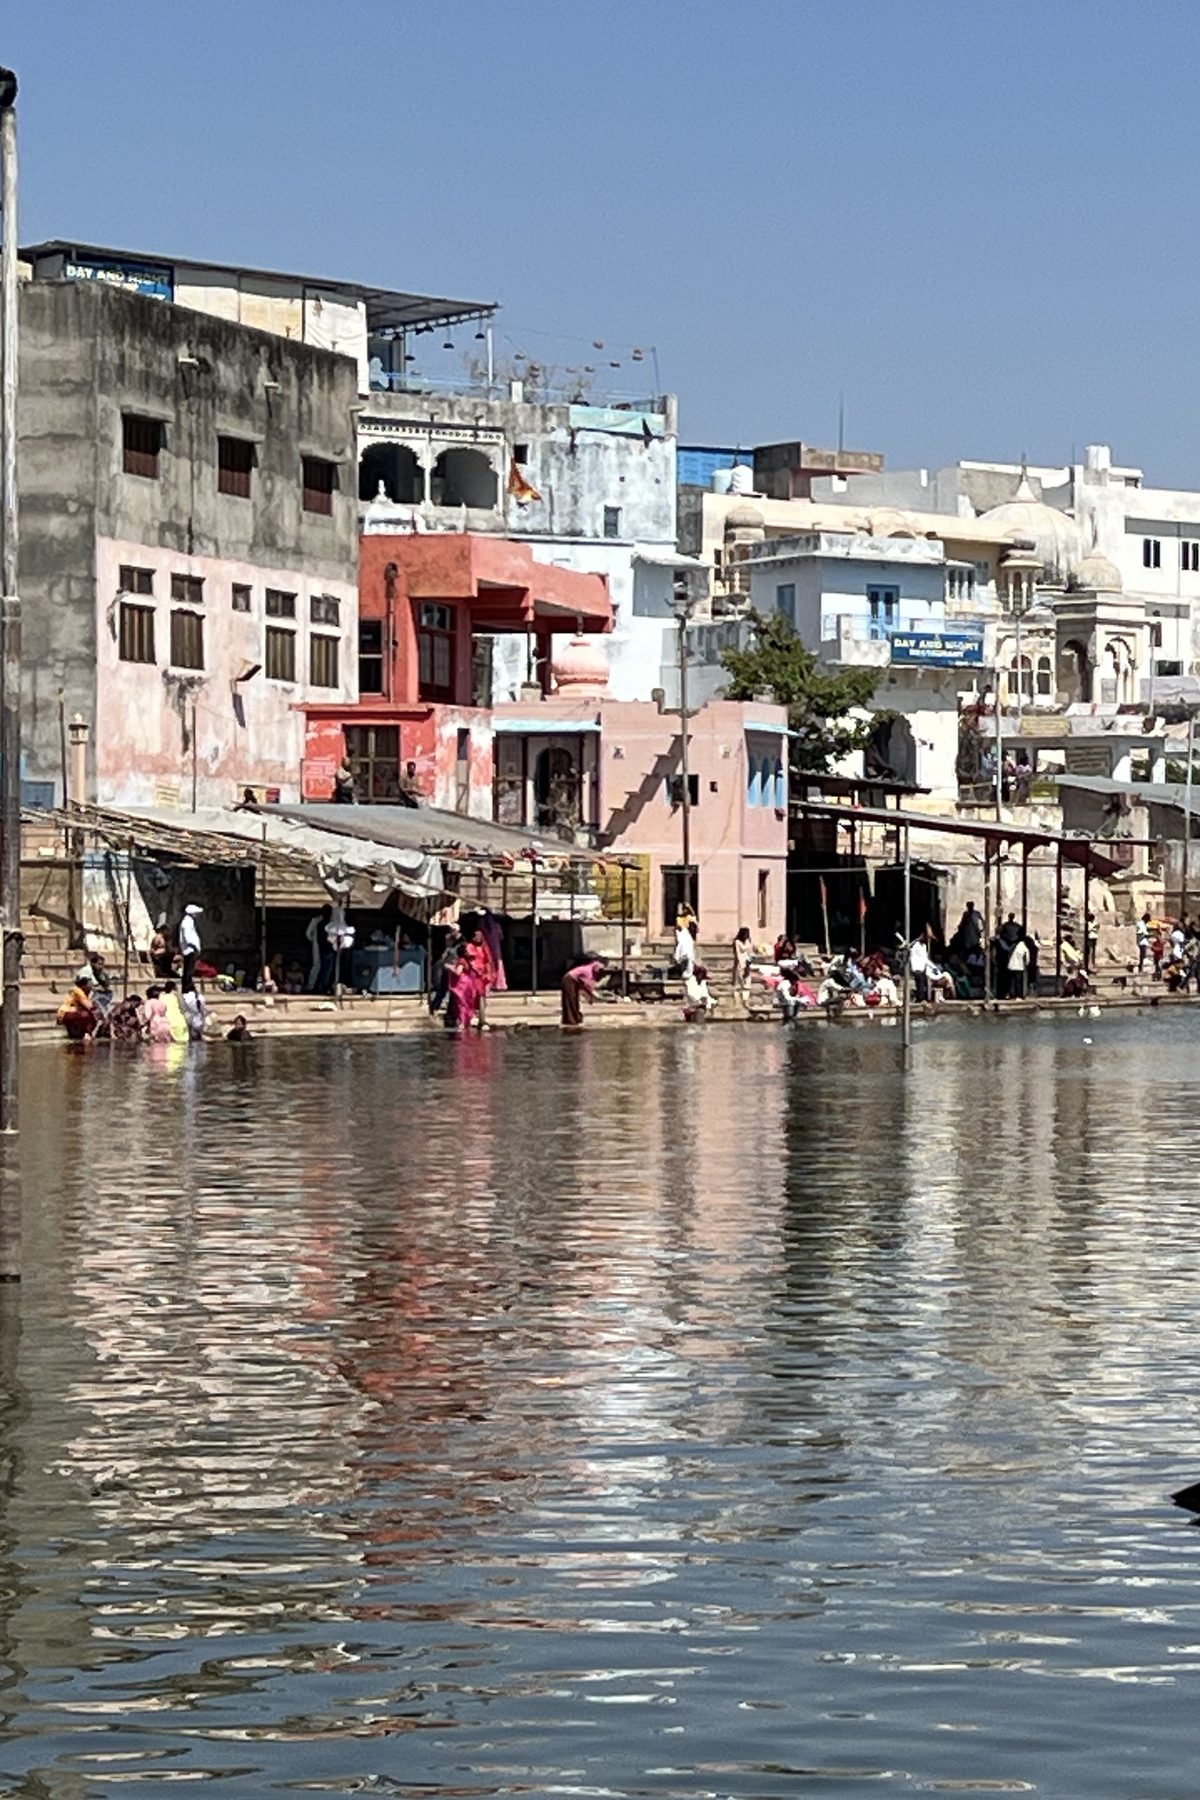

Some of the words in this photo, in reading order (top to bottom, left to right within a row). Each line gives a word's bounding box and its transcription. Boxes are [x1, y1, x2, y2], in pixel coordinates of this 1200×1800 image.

[66, 264, 94, 279] DAY
[97, 270, 125, 281] AND
[894, 638, 916, 648] DAY
[918, 640, 943, 649] AND
